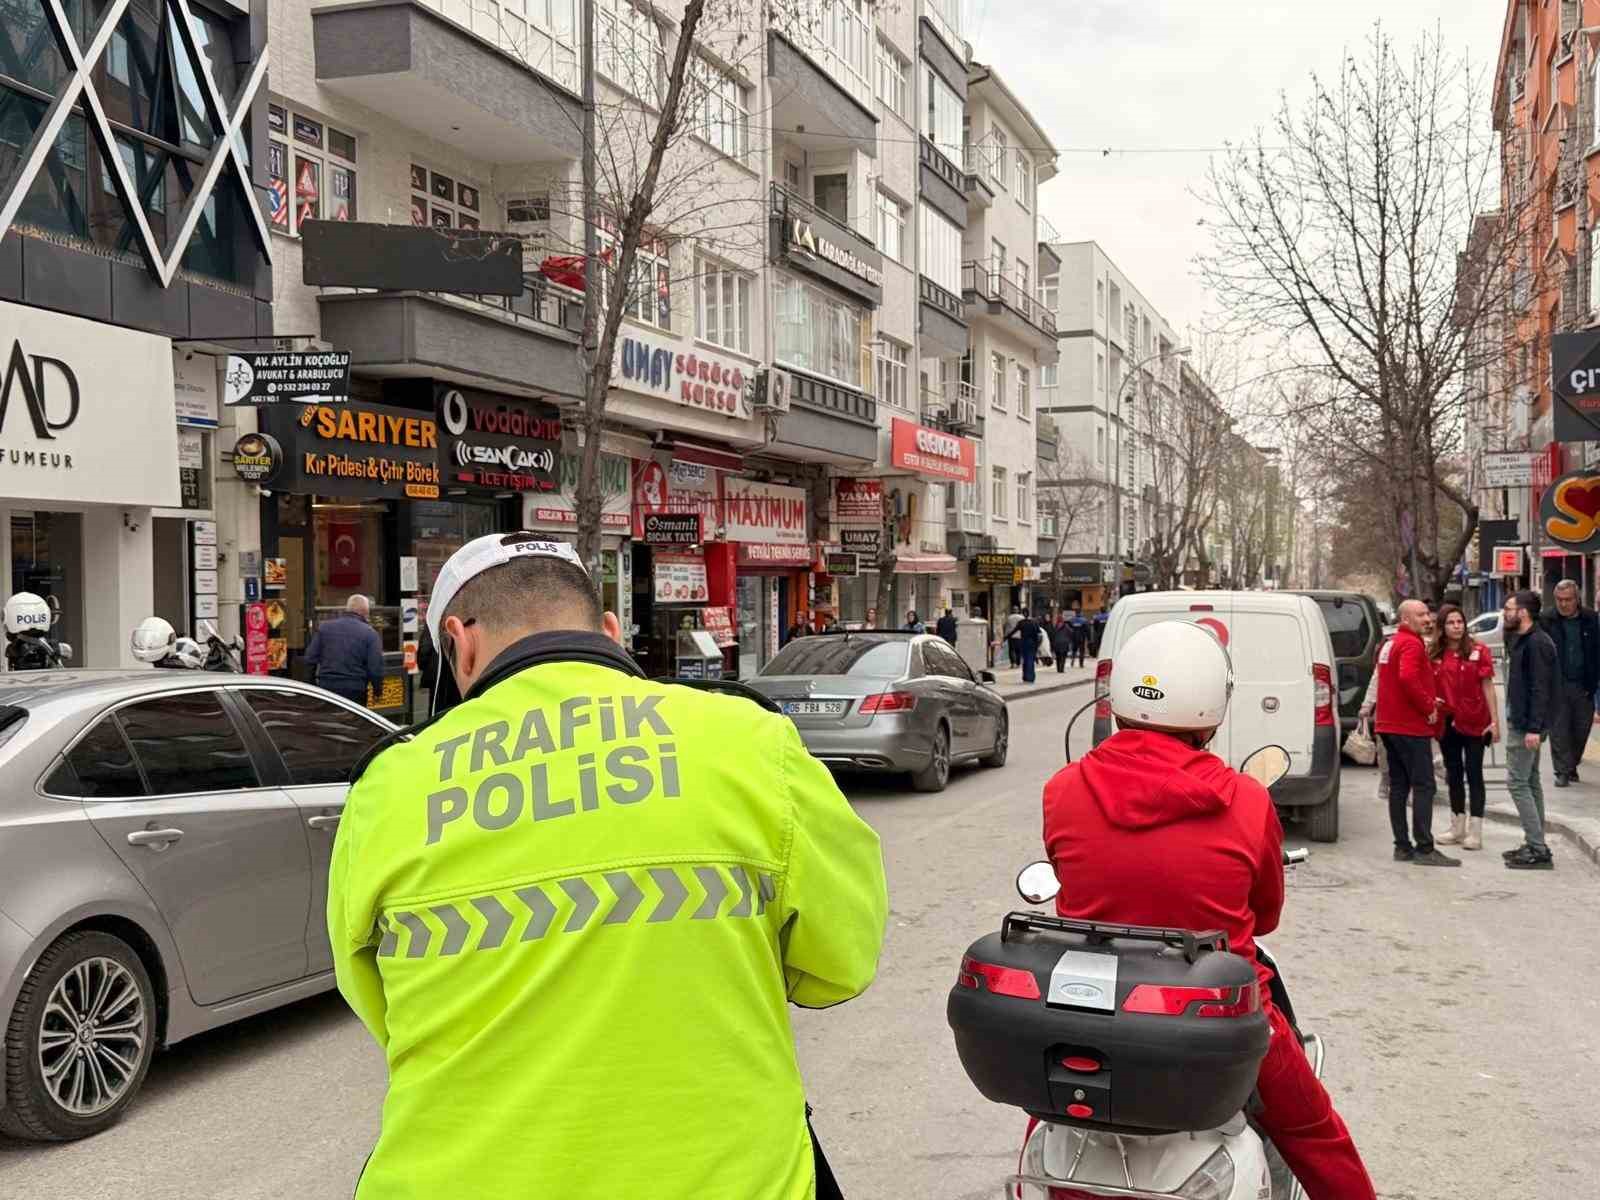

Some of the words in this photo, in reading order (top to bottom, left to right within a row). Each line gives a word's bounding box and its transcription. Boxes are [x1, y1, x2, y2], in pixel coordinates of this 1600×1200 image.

[254, 356, 269, 366] AV.
[271, 353, 302, 366] AYLİN
[305, 353, 348, 367] KOÇOĞLU
[622, 338, 673, 392] UMAY
[256, 370, 288, 379] AVUKAT
[297, 369, 344, 379] ARABULUCU
[317, 406, 437, 448] SARIYER
[234, 456, 271, 466] SARIYER
[305, 452, 326, 475] Kır
[327, 454, 366, 479] Pidesi
[367, 458, 378, 478] &
[406, 459, 440, 483] Börek
[646, 516, 698, 532] Osmanlı
[646, 532, 672, 543] SICAK
[674, 532, 698, 543] TATLI
[1135, 687, 1161, 699] JIEYI
